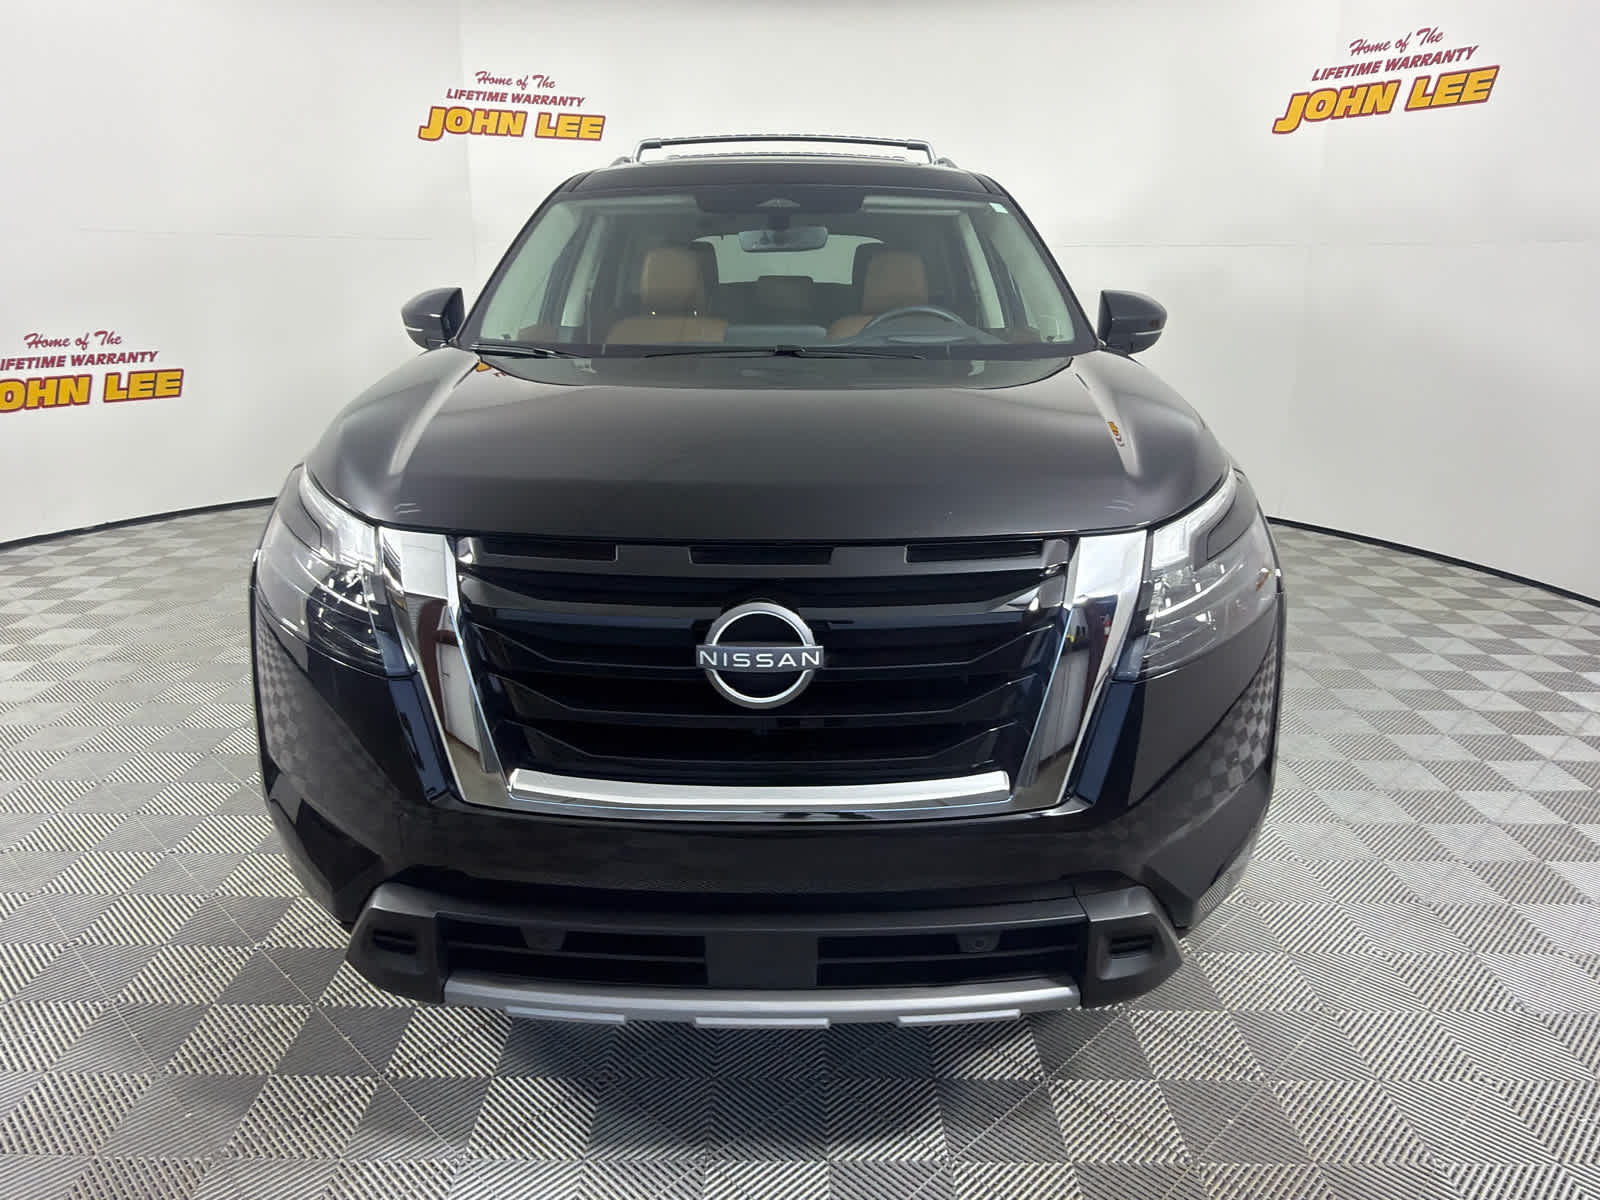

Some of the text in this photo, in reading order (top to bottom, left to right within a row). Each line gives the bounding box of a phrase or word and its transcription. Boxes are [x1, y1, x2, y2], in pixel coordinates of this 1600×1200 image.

[1349, 26, 1444, 56] Home of The
[1312, 45, 1479, 81] LIFETIME WARRANTY
[475, 71, 556, 90] Home of The
[446, 88, 586, 107] LIFETIME WARRANTY
[1272, 65, 1500, 134] JOHN LEE
[418, 106, 606, 141] JOHN LEE
[24, 330, 122, 351] Home of The
[0, 351, 159, 371] IFETIME WARRANTY
[0, 368, 184, 413] OHN LEE
[699, 650, 820, 668] NISSAN
